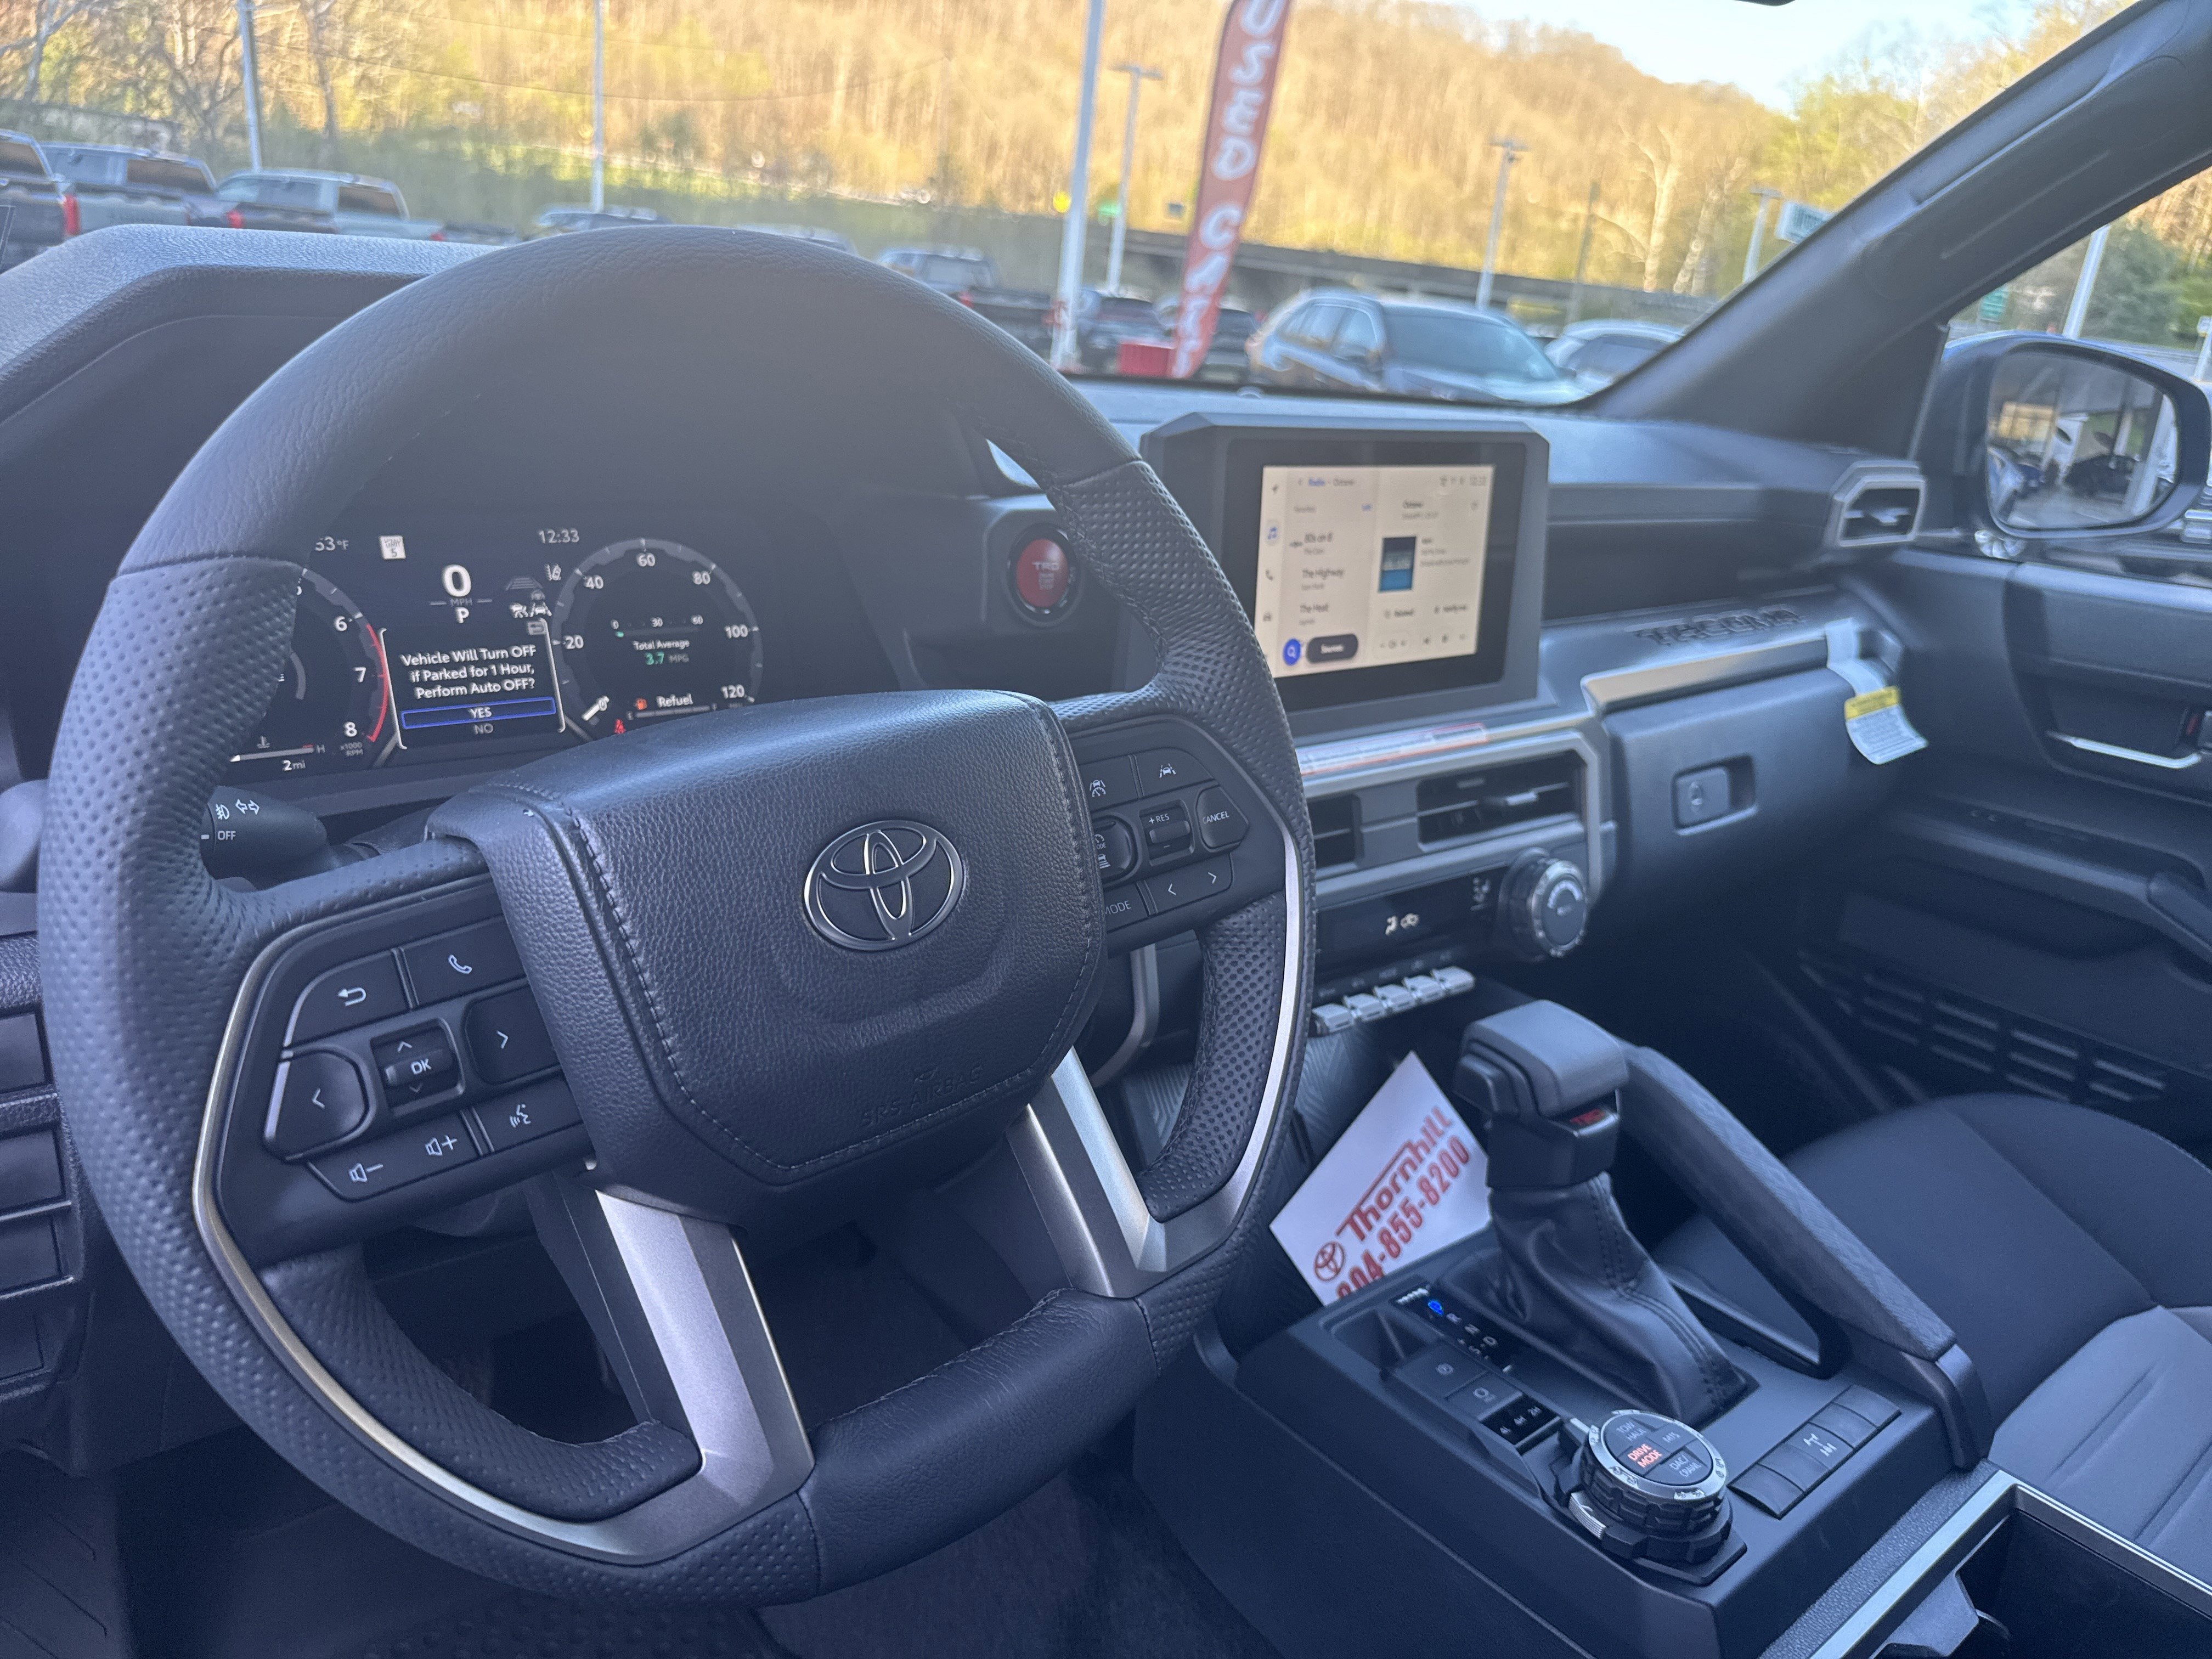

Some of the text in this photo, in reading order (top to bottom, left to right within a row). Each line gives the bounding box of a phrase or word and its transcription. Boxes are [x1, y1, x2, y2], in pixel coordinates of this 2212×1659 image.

[1212, 0, 1285, 180] USED
[538, 528, 579, 543] 12:33
[636, 553, 656, 567] 60
[442, 564, 472, 597] 0
[585, 575, 603, 589] 40
[692, 571, 711, 585] 80
[455, 607, 470, 624] P
[650, 617, 663, 628] 30
[334, 616, 348, 631] 6
[725, 624, 748, 638] 100
[565, 635, 584, 649] 20
[631, 639, 690, 651] Total Average
[399, 644, 537, 667] Vehicle Will Turn OFF
[645, 651, 664, 665] 3.7
[353, 666, 366, 683] 7
[410, 662, 535, 682] if Parked for 1 Hour,
[414, 677, 535, 699] Perform Auto OFF?
[721, 684, 745, 699] 120
[656, 692, 693, 708] Refuel
[468, 706, 492, 719] YES
[343, 721, 357, 737] 8
[473, 723, 493, 735] NO
[316, 744, 326, 753] H
[1202, 811, 1230, 824] CANCEL
[217, 830, 236, 841] OFF
[410, 1059, 432, 1074] OK
[1334, 1105, 1453, 1242] Thornhill
[1626, 1428, 1647, 1442] HAUL
[1627, 1443, 1652, 1462] DRIVE
[1637, 1449, 1662, 1469] MODE
